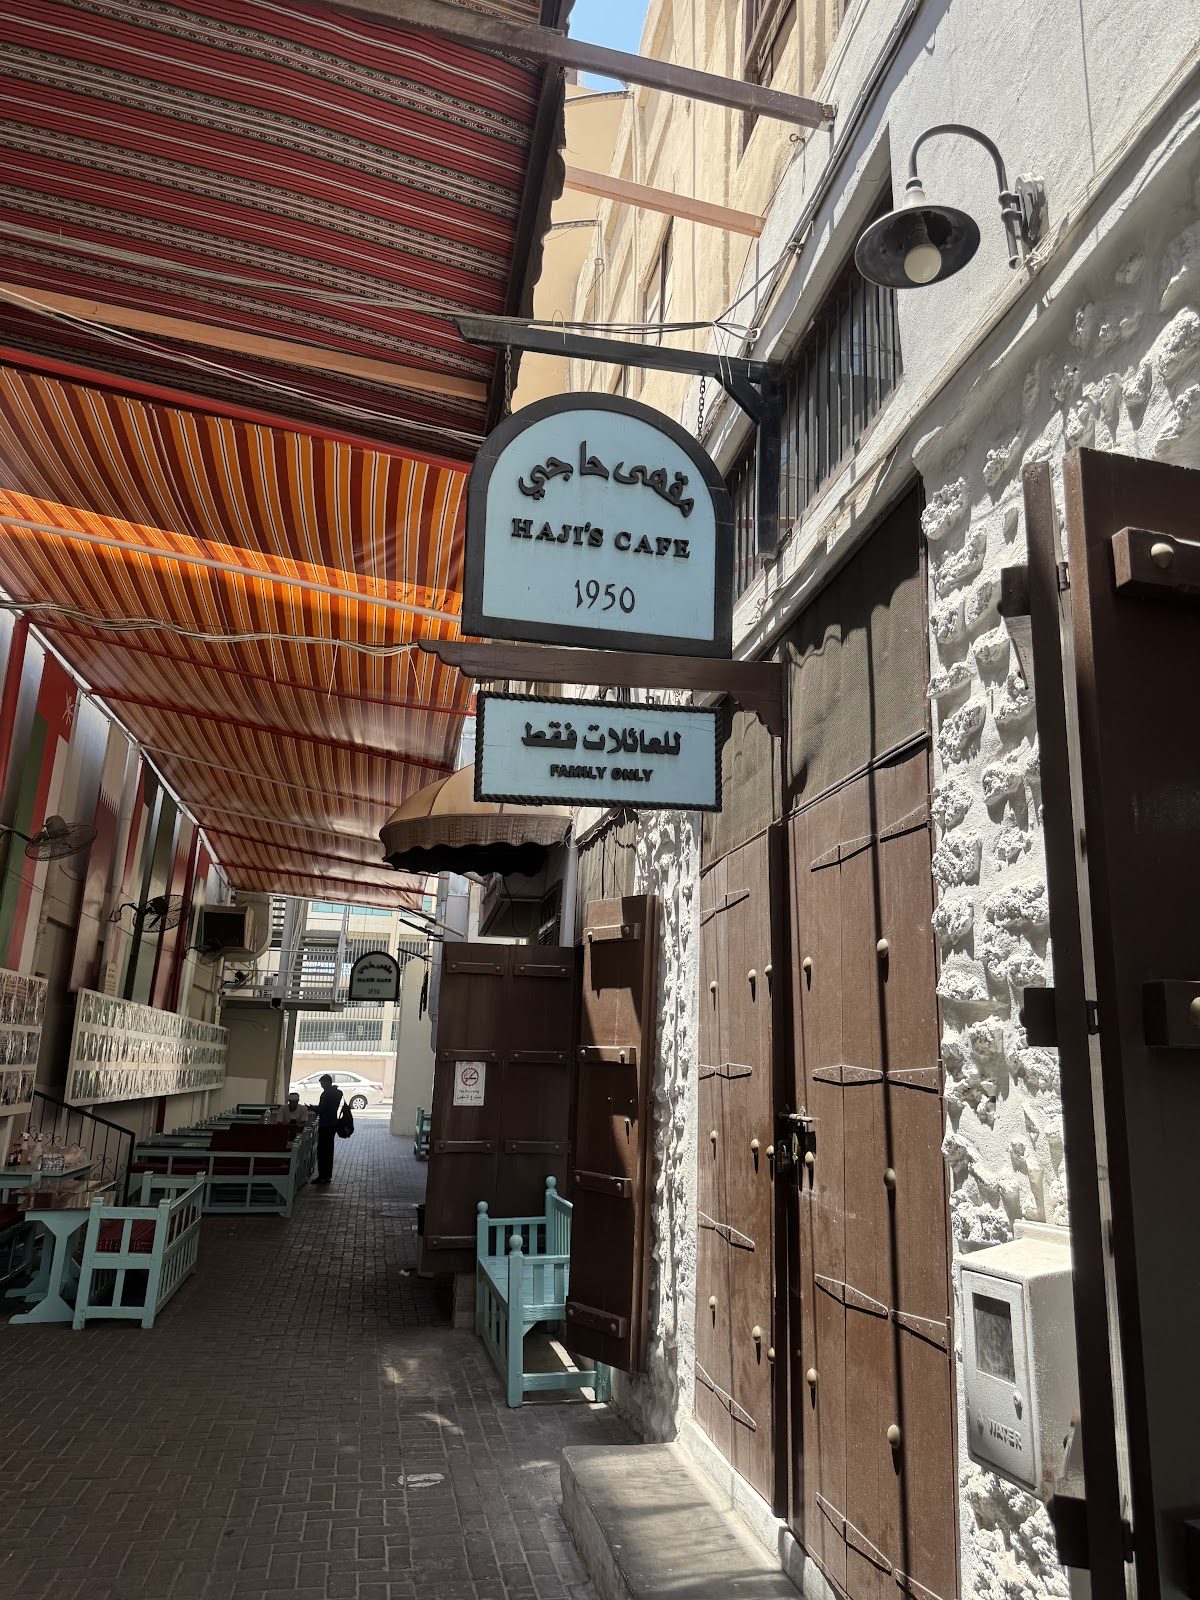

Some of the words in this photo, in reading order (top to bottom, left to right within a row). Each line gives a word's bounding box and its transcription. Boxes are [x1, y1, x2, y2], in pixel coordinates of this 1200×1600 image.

[518, 440, 610, 500] حاجي
[613, 461, 695, 518] مقهى
[511, 517, 604, 548] HAJI'S
[614, 531, 691, 558] CAFE
[574, 579, 636, 613] 1950
[521, 720, 578, 749] فقط
[582, 723, 682, 755] للعائلات
[550, 763, 608, 780] FAMILY
[611, 767, 654, 782] ONLY
[988, 1417, 1022, 1451] WATER
